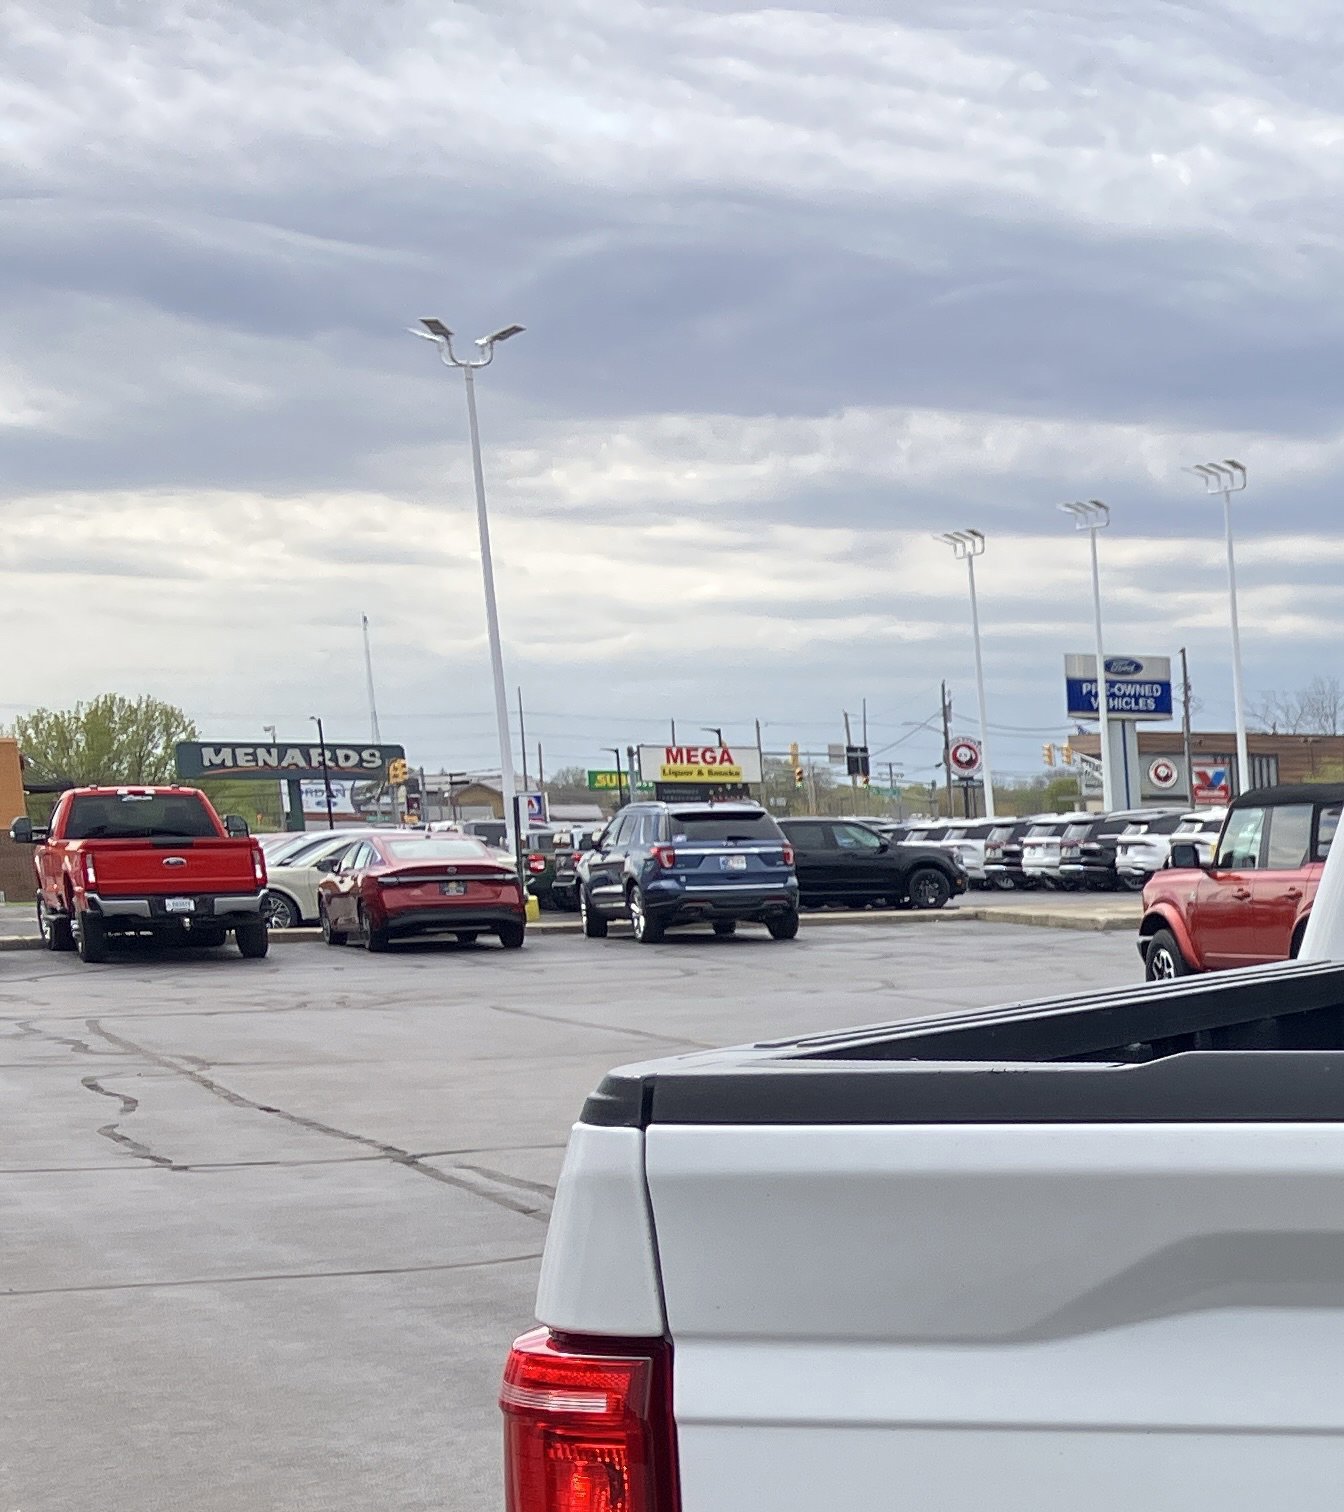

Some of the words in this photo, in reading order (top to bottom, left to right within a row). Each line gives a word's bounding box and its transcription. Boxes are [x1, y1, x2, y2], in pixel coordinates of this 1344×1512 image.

[1090, 696, 1156, 711] VHICLES
[201, 747, 383, 769] MENARDS
[665, 746, 734, 765] MEGA
